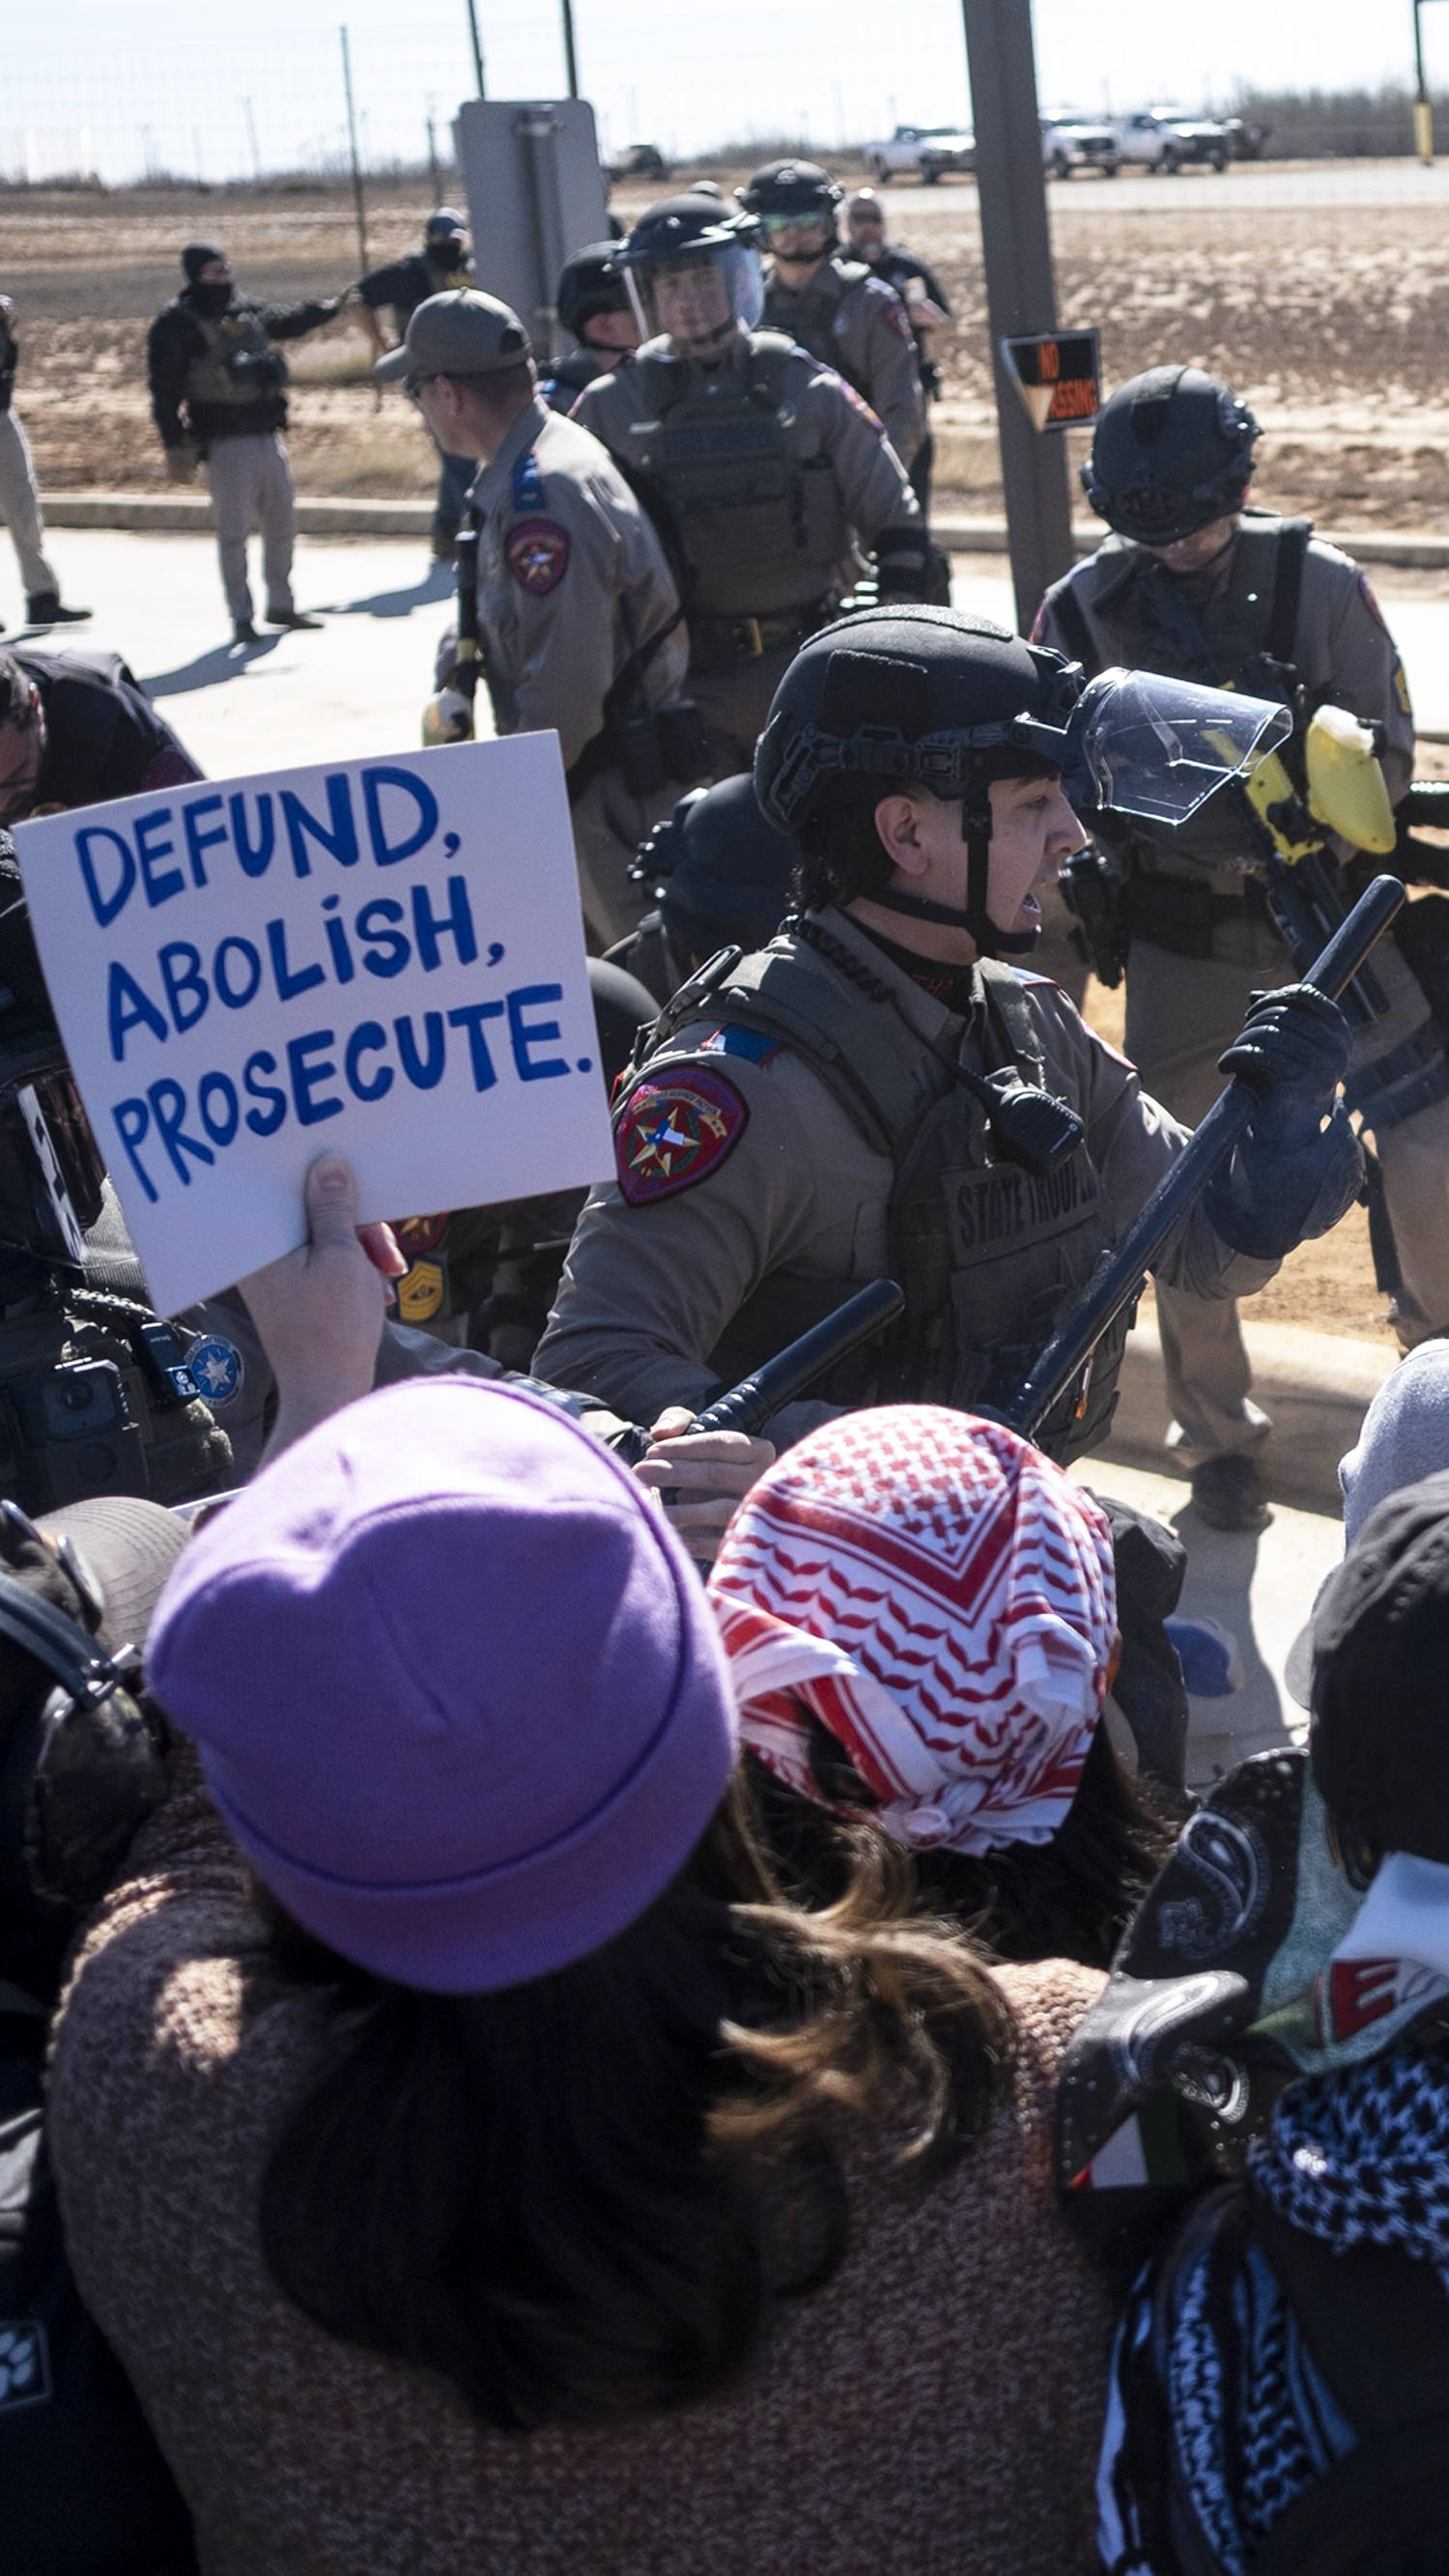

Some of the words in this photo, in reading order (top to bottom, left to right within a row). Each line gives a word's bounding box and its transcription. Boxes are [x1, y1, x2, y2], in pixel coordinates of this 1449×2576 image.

[73, 766, 461, 928] DEFUND,
[111, 983, 592, 1203] PROSECUTE.
[956, 1174, 1025, 1250] STATE
